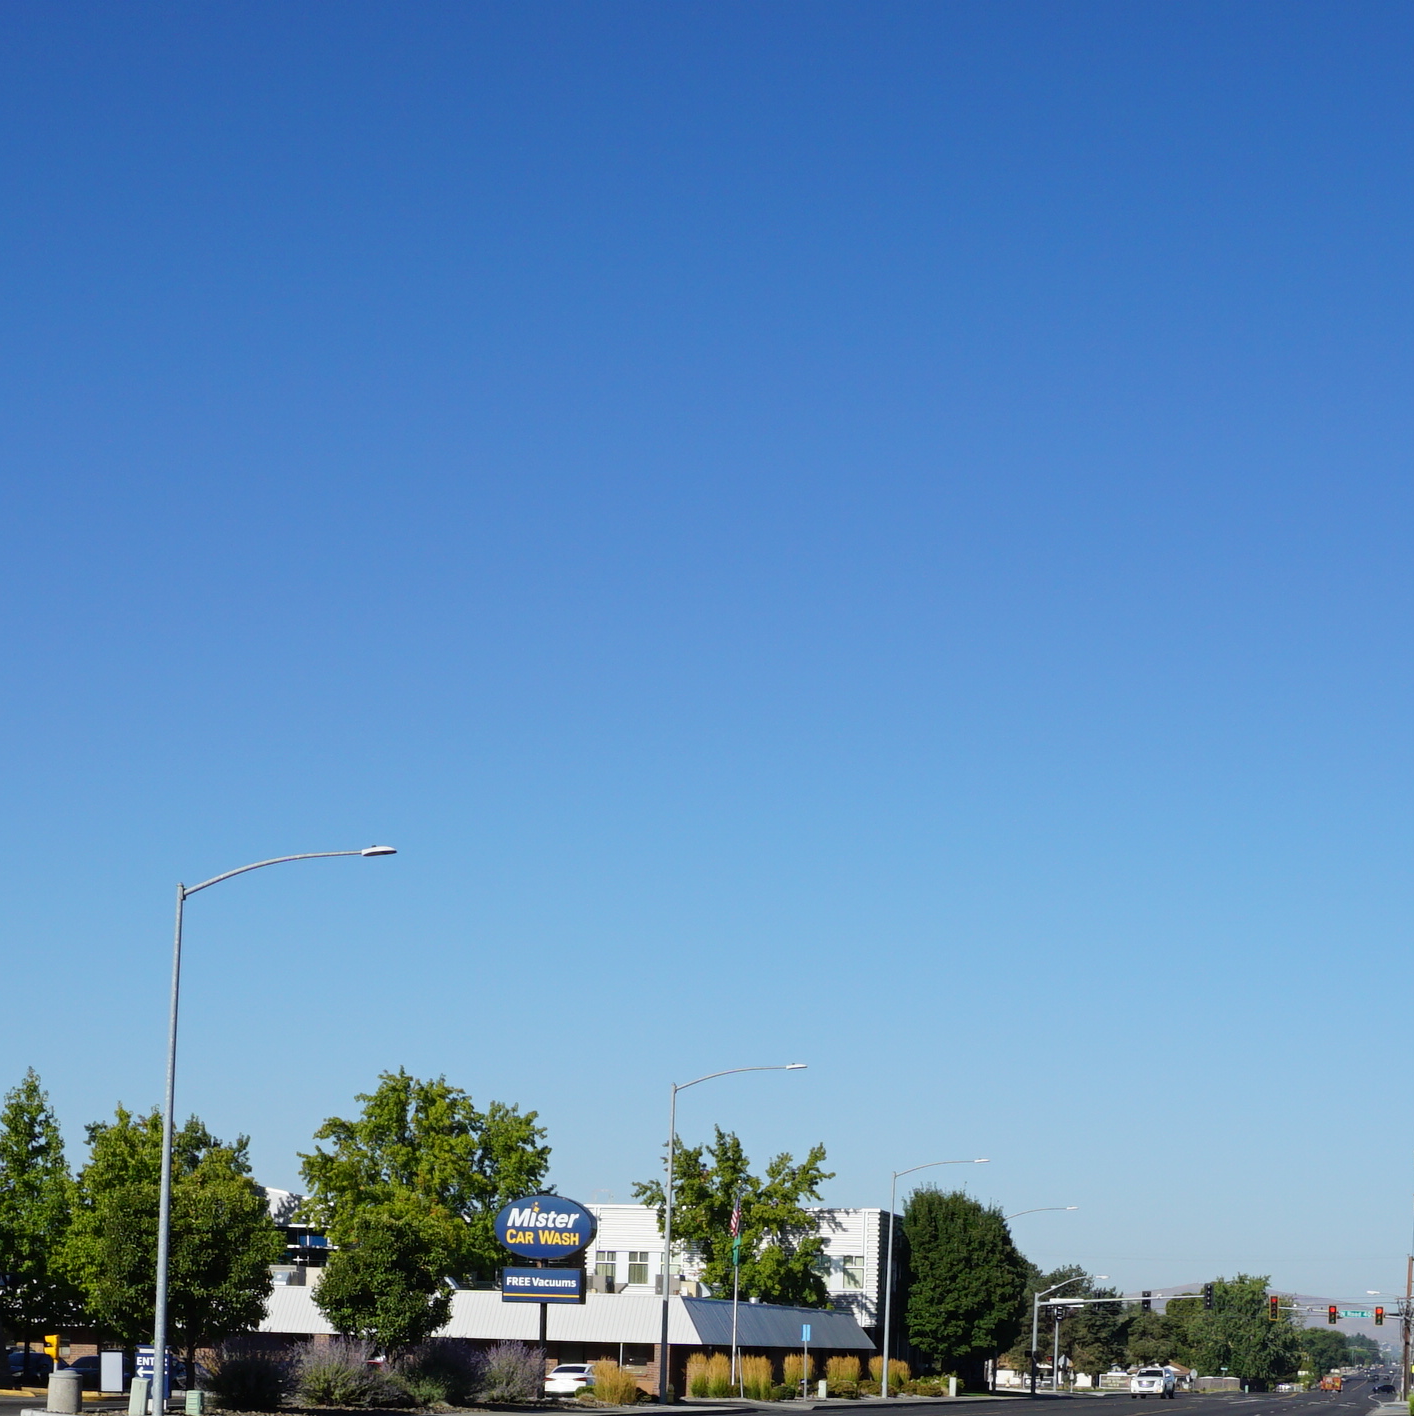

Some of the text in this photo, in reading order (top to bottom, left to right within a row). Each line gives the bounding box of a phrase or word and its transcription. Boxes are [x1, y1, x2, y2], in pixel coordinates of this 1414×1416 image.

[506, 1206, 580, 1229] Mister
[506, 1228, 580, 1246] CAR WASH
[506, 1276, 577, 1288] FREE Vacuums
[136, 1356, 167, 1366] ENT
